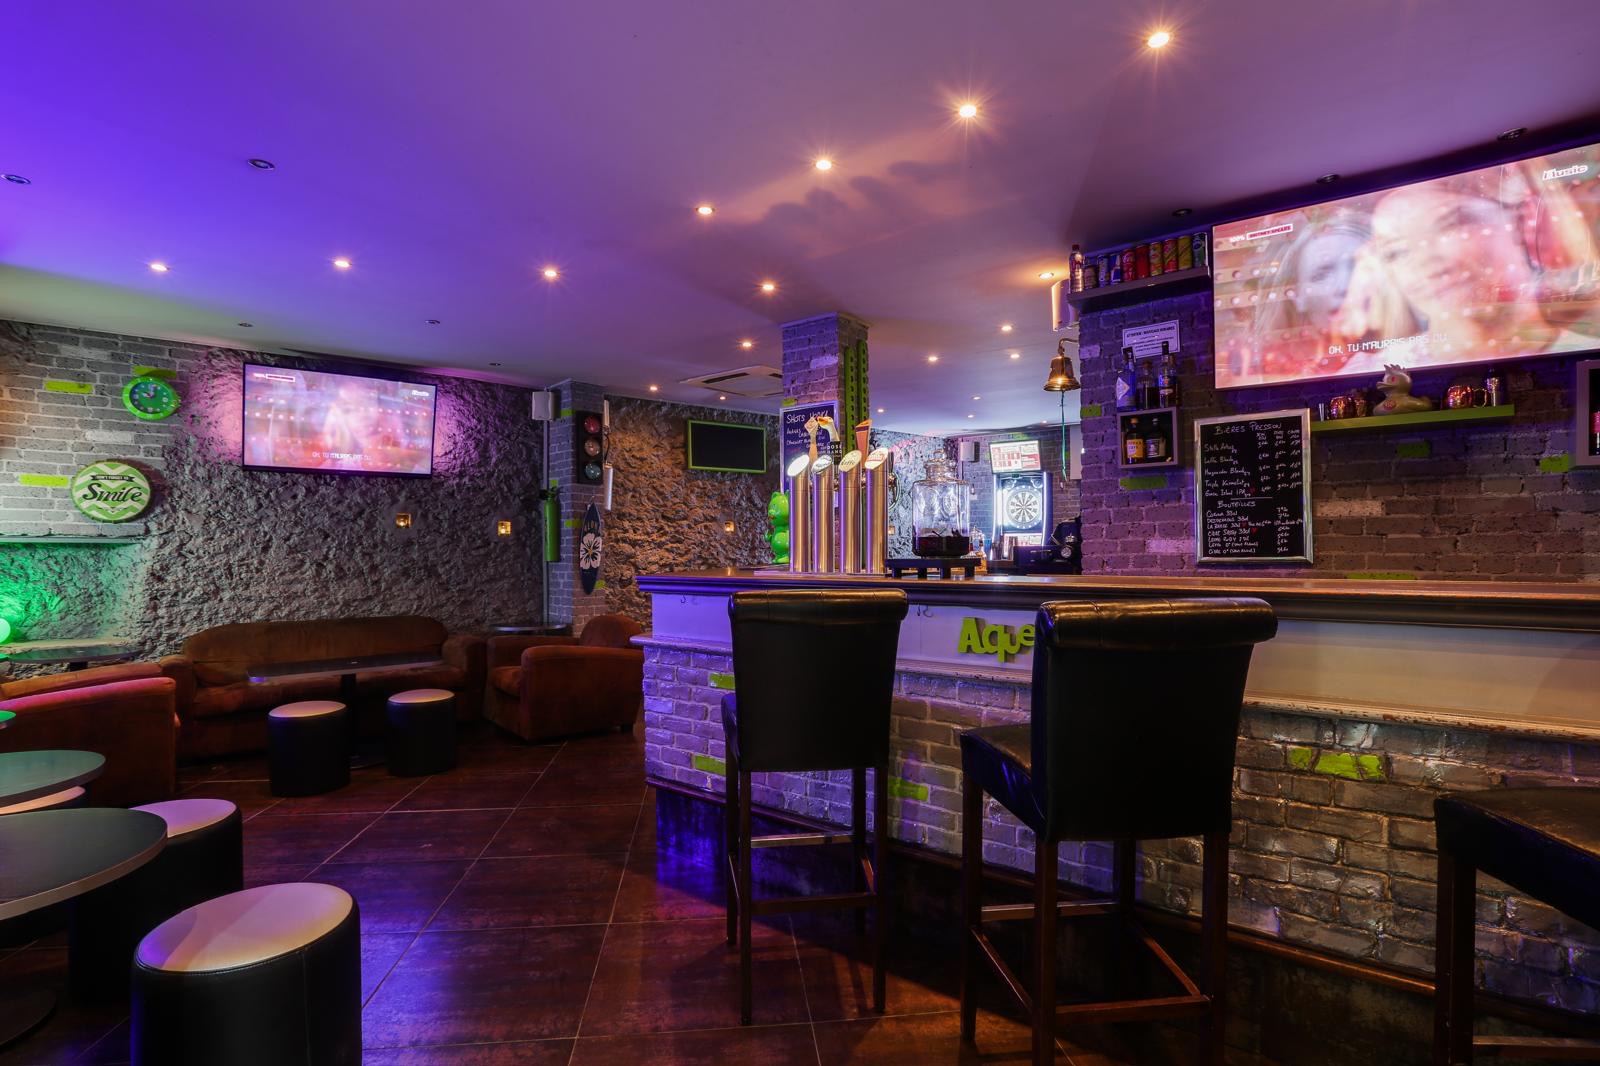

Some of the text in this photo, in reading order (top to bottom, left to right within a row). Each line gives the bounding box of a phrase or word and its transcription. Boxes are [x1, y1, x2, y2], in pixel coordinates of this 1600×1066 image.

[1347, 344, 1359, 352] TU
[82, 482, 142, 502] Smile
[958, 617, 1036, 663] Aque
